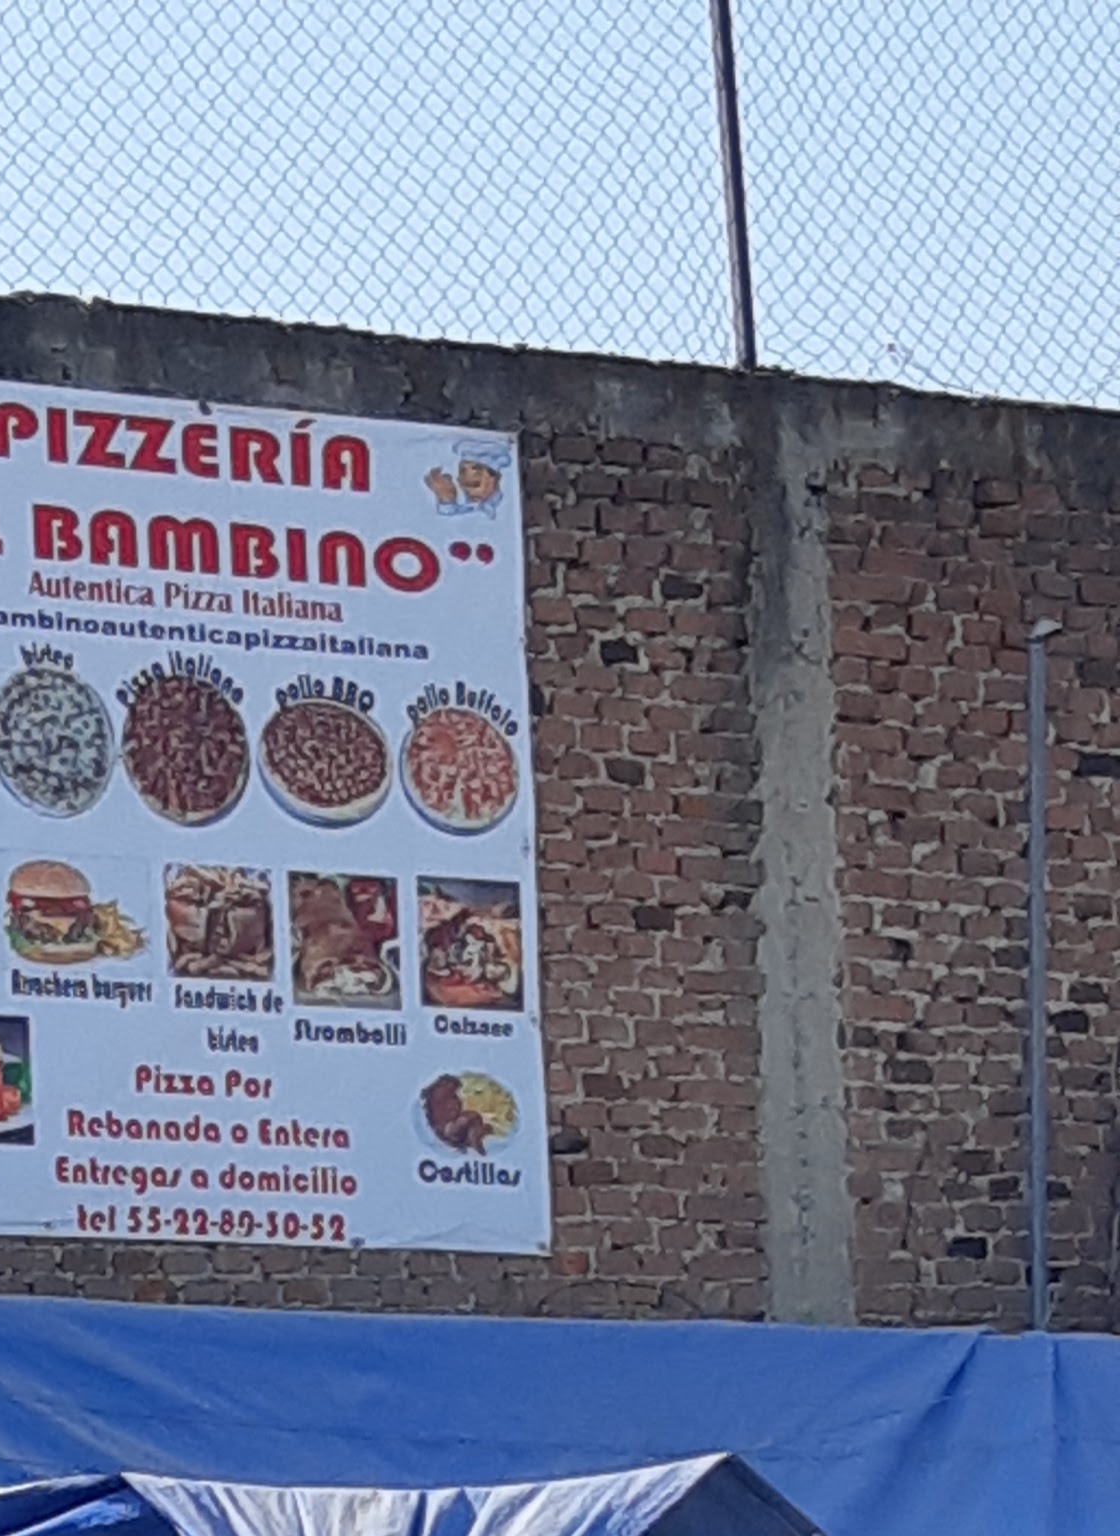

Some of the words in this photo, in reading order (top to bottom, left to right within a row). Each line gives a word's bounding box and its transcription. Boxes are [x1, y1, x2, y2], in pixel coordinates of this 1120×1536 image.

[28, 571, 155, 607] Autentica
[164, 582, 233, 614] Pizza
[242, 589, 344, 623] Italiana
[174, 983, 257, 1012] Sandwich
[262, 988, 284, 1013] de
[135, 1064, 215, 1096] Pizza
[225, 1069, 272, 1098] Por
[67, 1108, 221, 1143] Rebanada
[231, 1123, 249, 1144] o
[258, 1118, 351, 1149] Entera
[55, 1155, 182, 1195] Entregas
[190, 1167, 209, 1189] a
[418, 1159, 522, 1188] Costillas
[77, 1204, 118, 1232] tel
